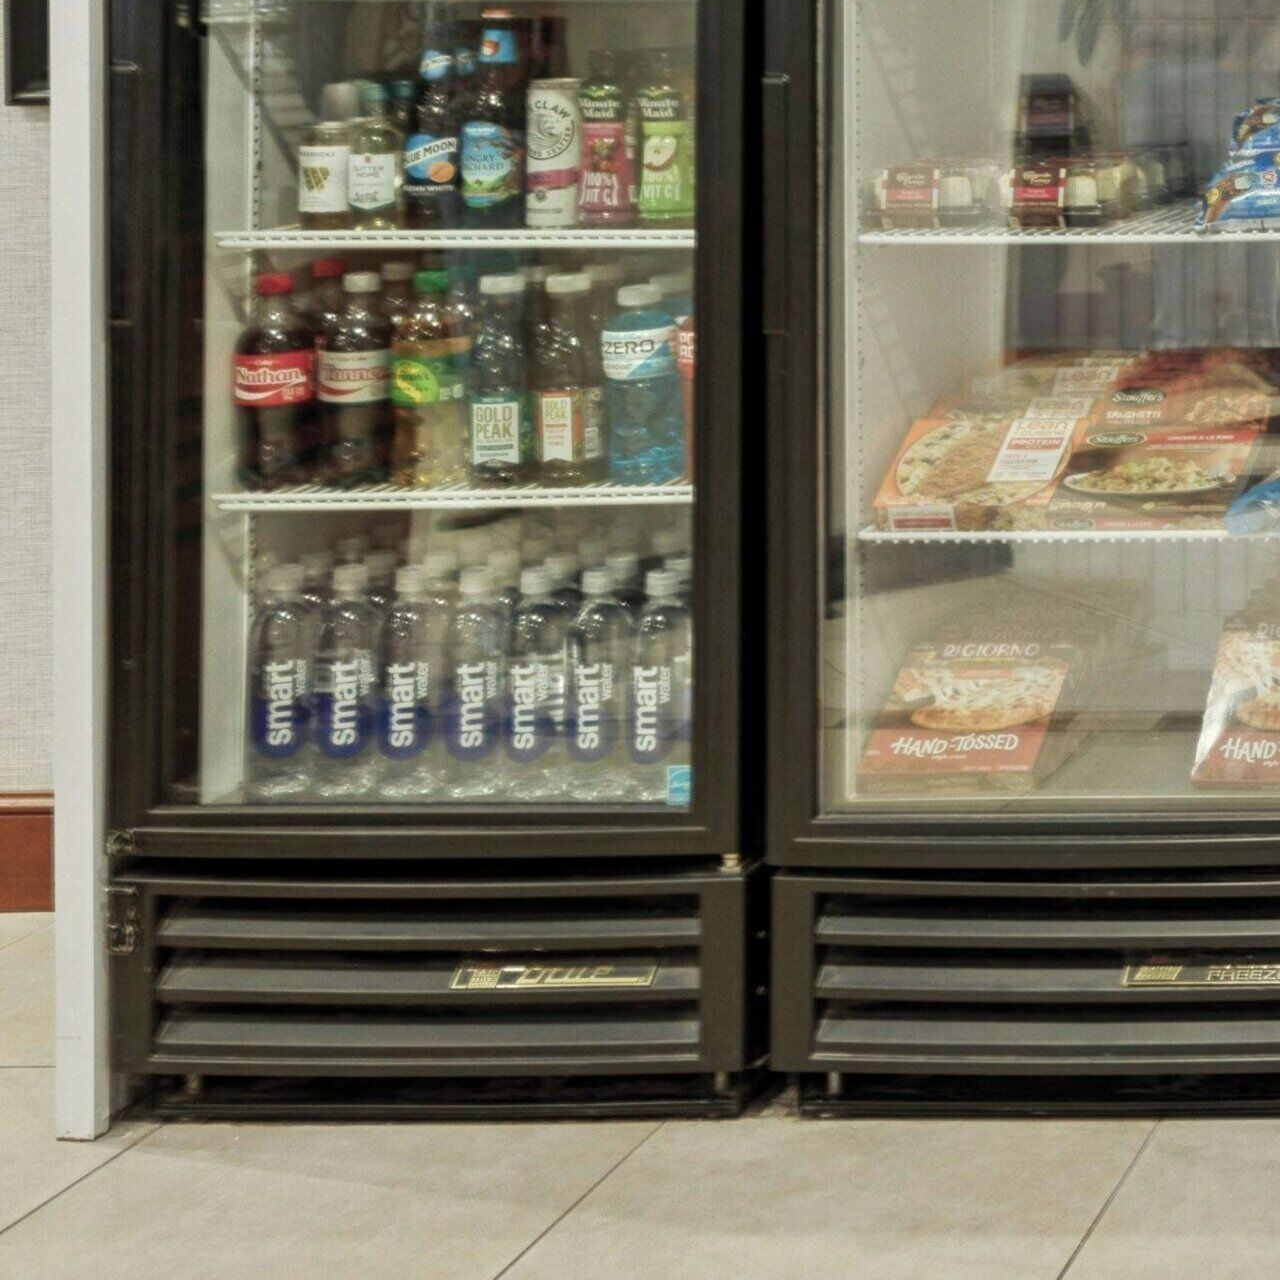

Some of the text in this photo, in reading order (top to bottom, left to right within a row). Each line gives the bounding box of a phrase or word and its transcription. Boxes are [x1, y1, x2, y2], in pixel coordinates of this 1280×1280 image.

[535, 101, 570, 120] CLAW
[580, 98, 620, 108] Minute
[642, 108, 674, 117] Maid
[583, 109, 614, 118] Maid
[422, 139, 455, 156] MOON
[603, 339, 655, 354] ZERO
[236, 366, 300, 385] Nathan
[1112, 390, 1164, 403] Stouffer's
[476, 406, 513, 422] GOLD
[1105, 410, 1162, 420] SPAGHETTI
[476, 422, 514, 438] PEAK
[1096, 434, 1139, 444] Stouffer's
[416, 662, 430, 698] water
[658, 665, 672, 704] water
[265, 659, 294, 746] smart
[330, 661, 358, 746] smart
[387, 661, 415, 748] smart
[456, 661, 485, 749] smart
[510, 663, 537, 750] smart
[574, 663, 602, 750] smart
[634, 666, 658, 752] smart
[890, 733, 1019, 756] HAND-TOSSED
